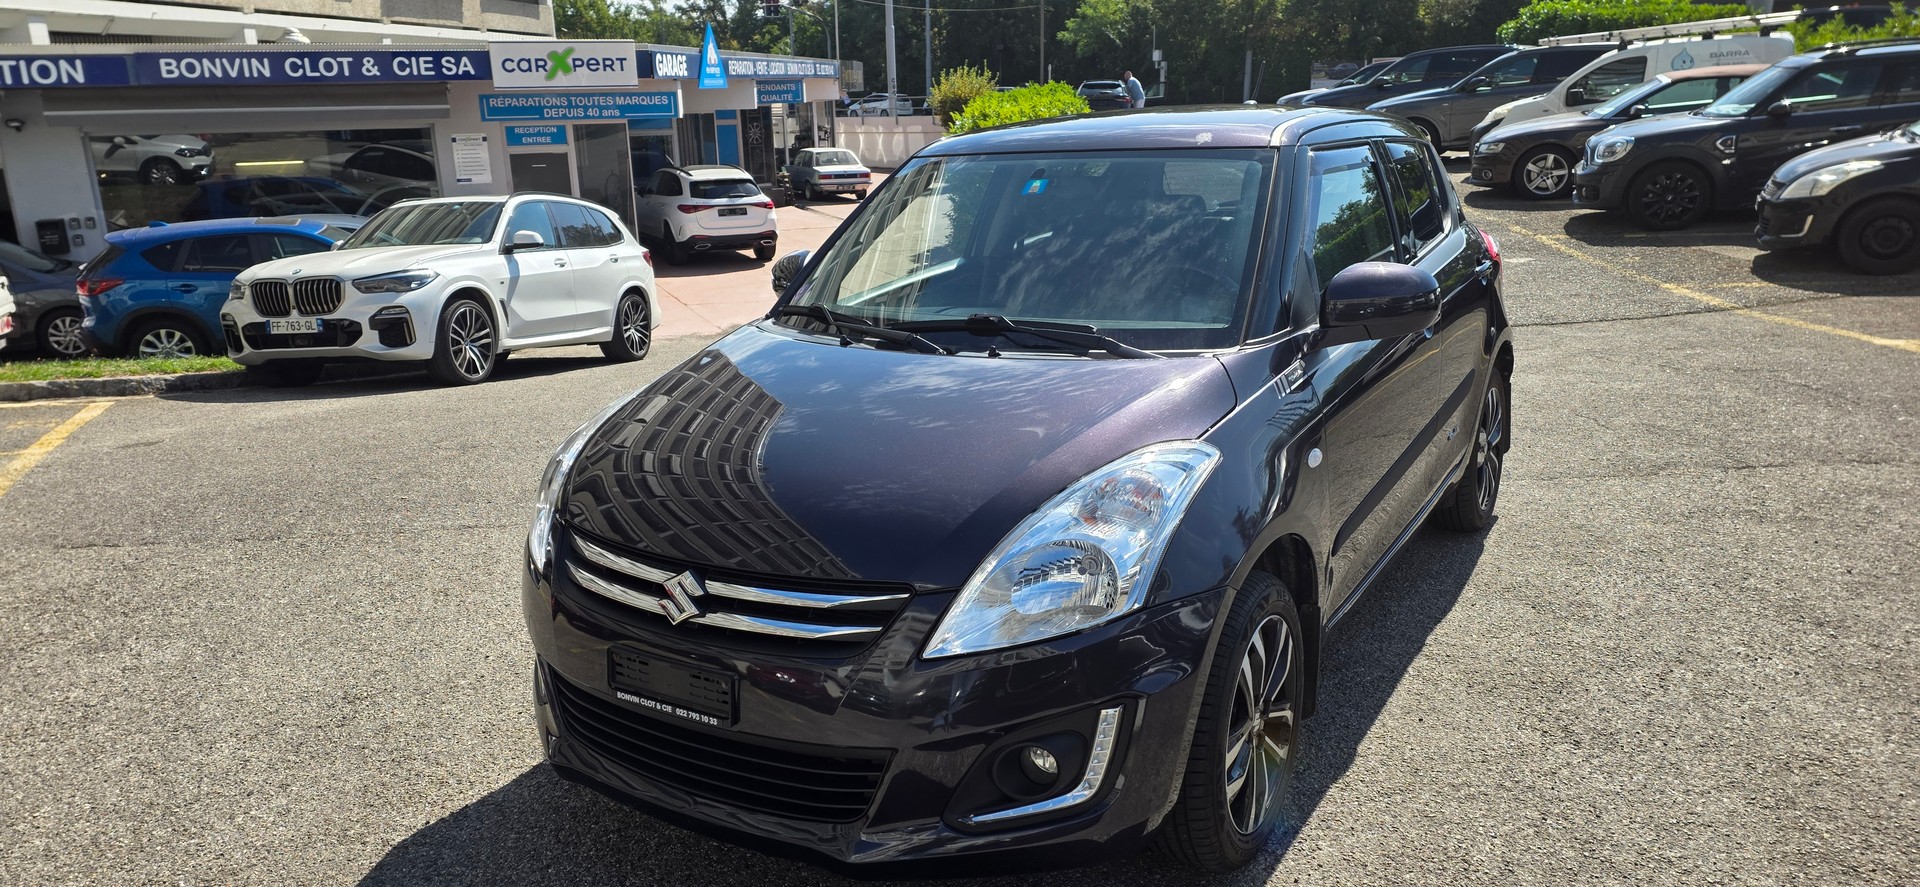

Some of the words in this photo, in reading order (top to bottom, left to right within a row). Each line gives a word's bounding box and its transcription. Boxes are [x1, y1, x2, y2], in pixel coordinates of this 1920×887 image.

[1710, 50, 1750, 58] BARRA
[159, 57, 271, 79] BONVIN
[284, 57, 353, 78] CLOT
[361, 57, 381, 77] &
[392, 56, 436, 76] CIE
[441, 56, 476, 76] SA
[655, 52, 688, 77] GARAGE
[728, 60, 754, 75] REPARATION
[0, 59, 85, 85] TION
[489, 96, 567, 107] RÉPARATIONS
[570, 95, 613, 106] TOUTES
[616, 95, 668, 106] MARQUES
[761, 94, 793, 102] QUALITÉ
[544, 108, 584, 118] DEPUIS
[587, 108, 599, 117] 40
[603, 109, 620, 117] ans
[514, 126, 557, 134] RECEPTION
[271, 320, 316, 331] FF-763-GL
[617, 692, 639, 704] BONVIN
[640, 698, 655, 708] CLOT
[656, 702, 661, 710] &
[662, 704, 672, 713] CIE
[675, 708, 688, 717] 022
[688, 711, 700, 720] 793
[701, 715, 708, 723] 10
[709, 717, 718, 726] 33
